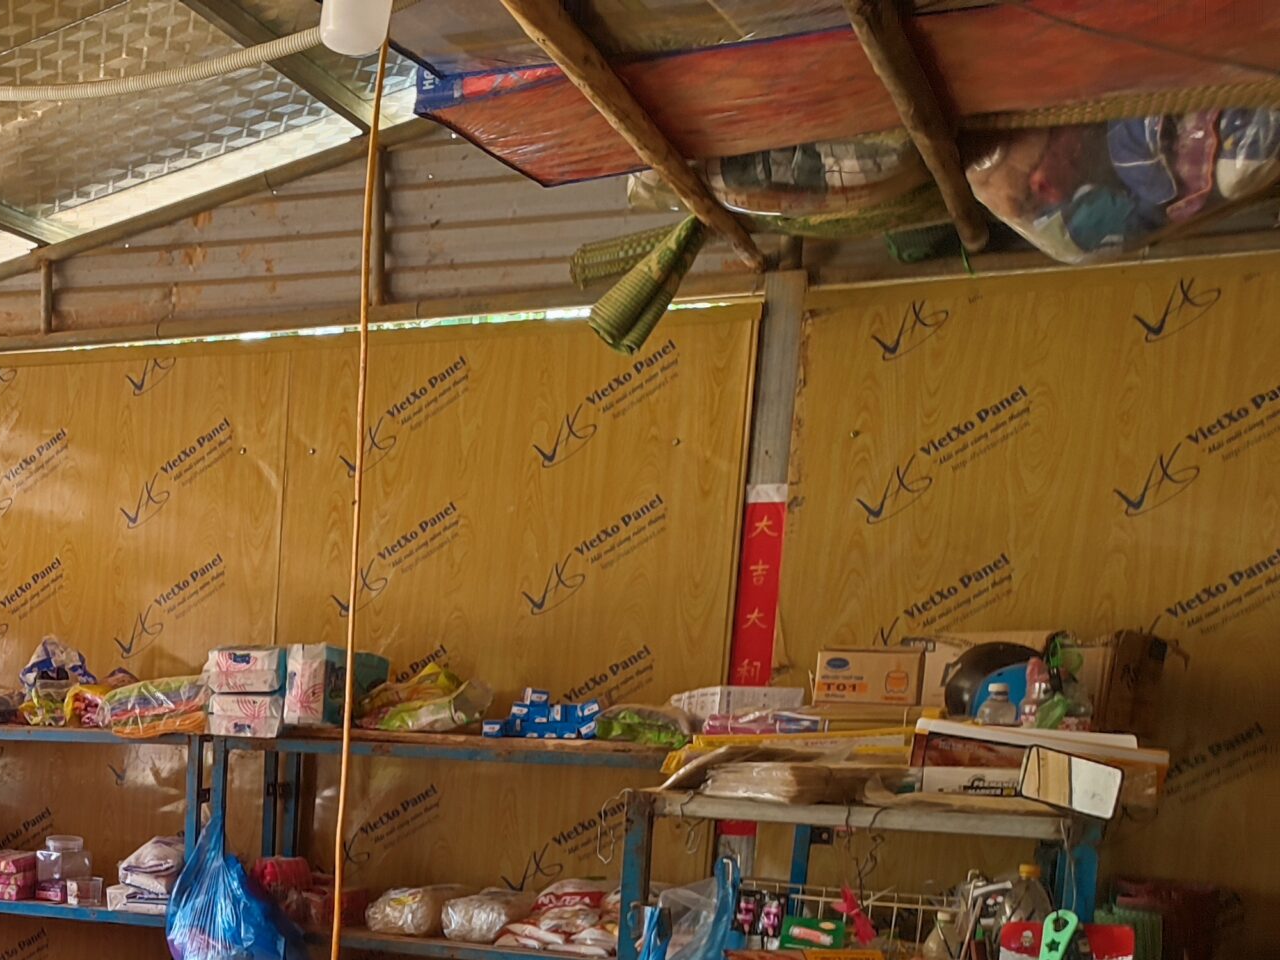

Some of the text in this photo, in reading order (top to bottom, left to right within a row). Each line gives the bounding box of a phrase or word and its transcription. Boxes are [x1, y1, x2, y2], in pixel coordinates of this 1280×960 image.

[427, 355, 466, 389] Panel
[633, 339, 676, 375] Panel
[976, 385, 1028, 423] Panel
[197, 417, 230, 448] Panel
[419, 501, 457, 533] Panel
[621, 493, 664, 528] Panel
[32, 557, 62, 584] Panel
[190, 553, 223, 582] Panel
[959, 552, 1009, 588] Panel
[609, 645, 651, 676] Panel
